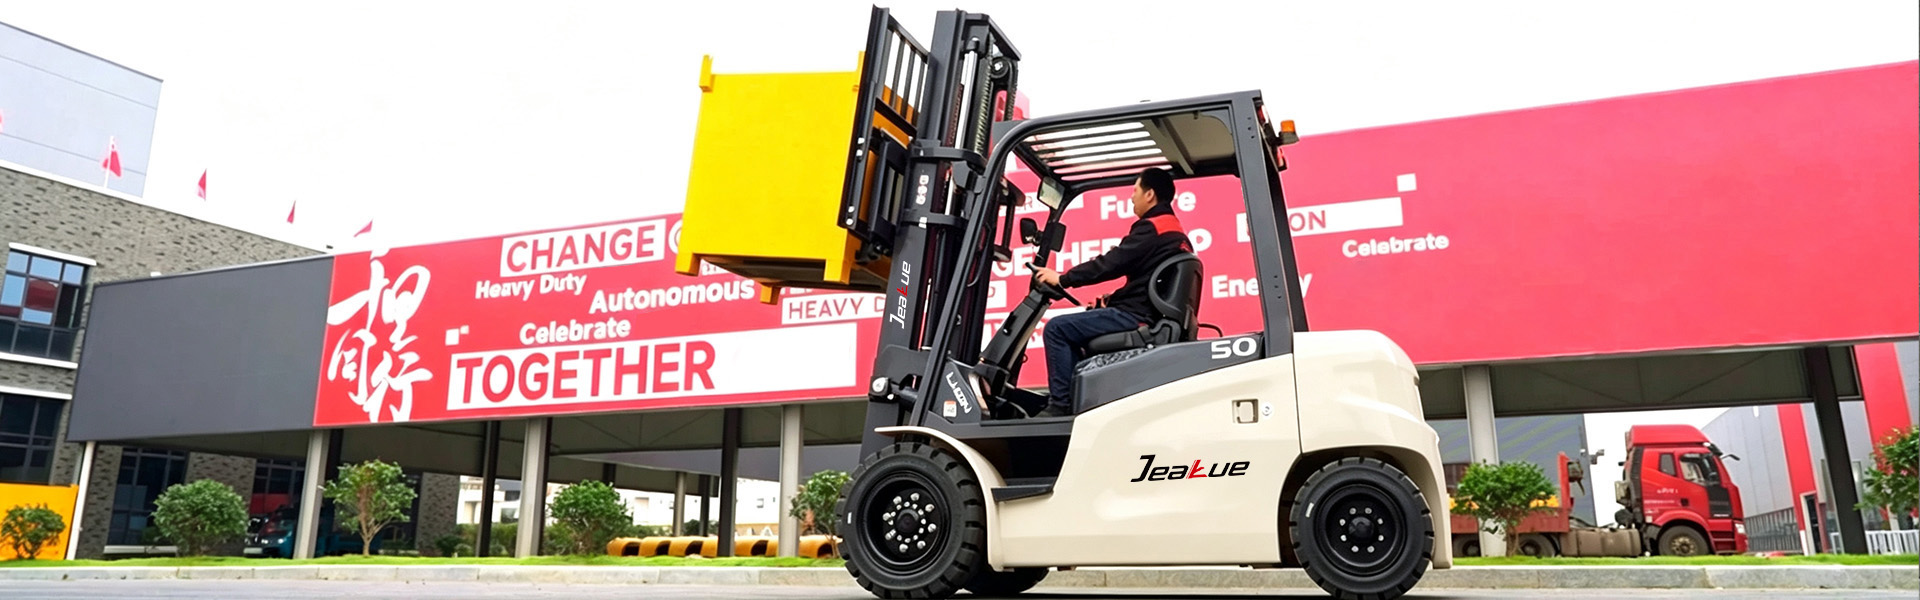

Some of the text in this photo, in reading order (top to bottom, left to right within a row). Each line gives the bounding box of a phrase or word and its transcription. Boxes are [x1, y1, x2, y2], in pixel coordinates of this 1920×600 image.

[506, 225, 656, 273] CHANGE
[1342, 233, 1450, 258] Celebrate
[475, 273, 587, 301] Heavy Duty
[589, 279, 755, 314] Autonomous
[788, 296, 865, 320] HEAVY
[519, 317, 631, 345] Celebrate
[1211, 337, 1257, 360] 50
[456, 340, 716, 404] TOGETHER
